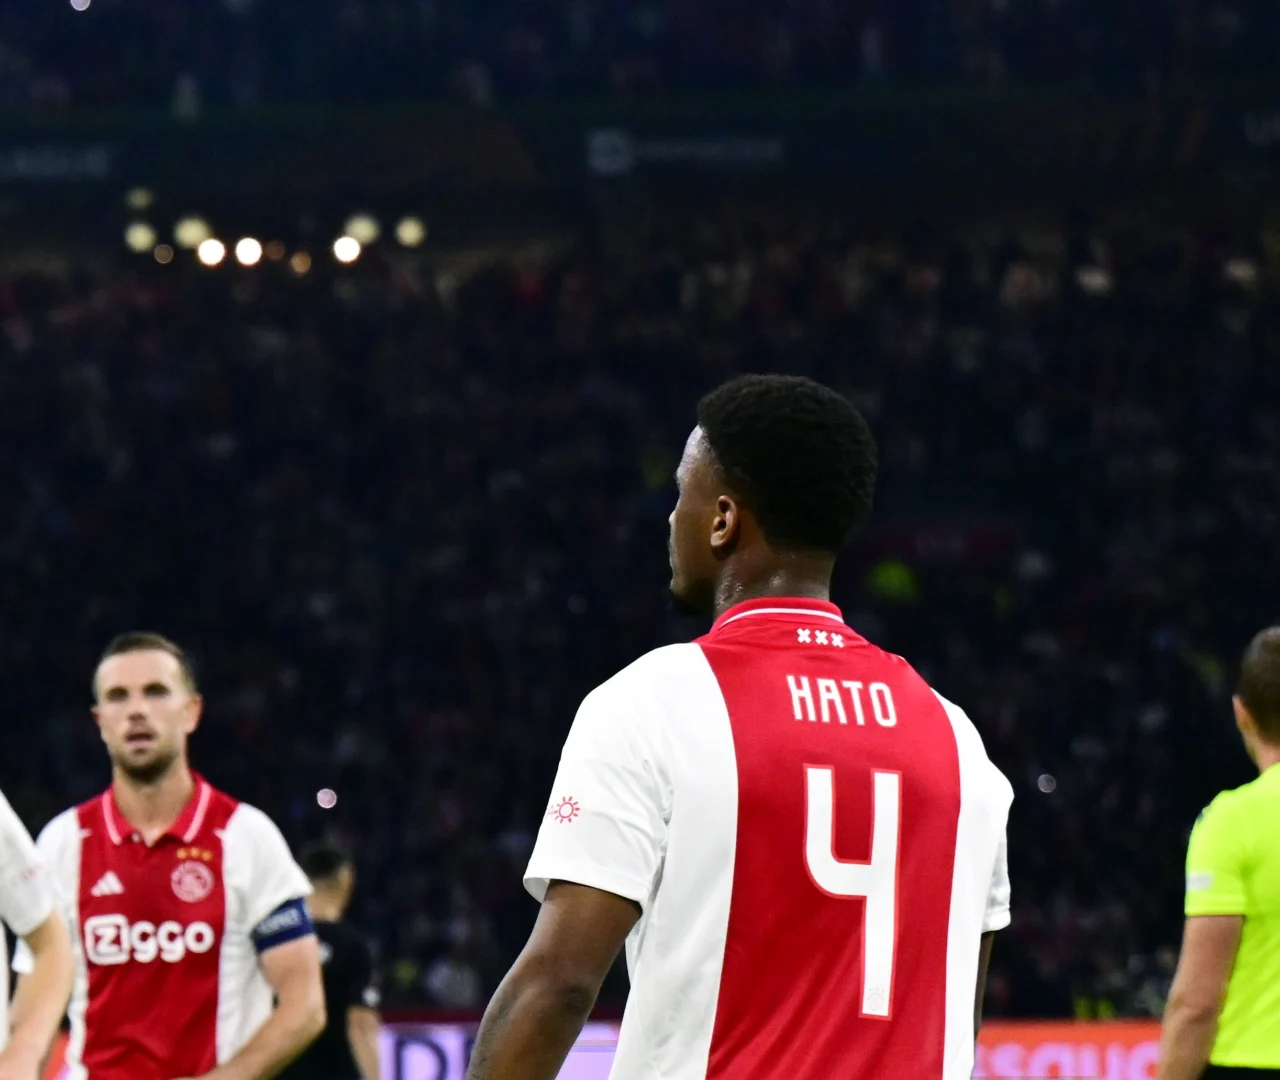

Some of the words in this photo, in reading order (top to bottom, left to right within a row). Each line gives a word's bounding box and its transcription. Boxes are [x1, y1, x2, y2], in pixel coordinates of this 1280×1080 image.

[786, 674, 897, 727] HATO
[803, 763, 902, 1021] 4
[84, 914, 214, 965] Ziggo
